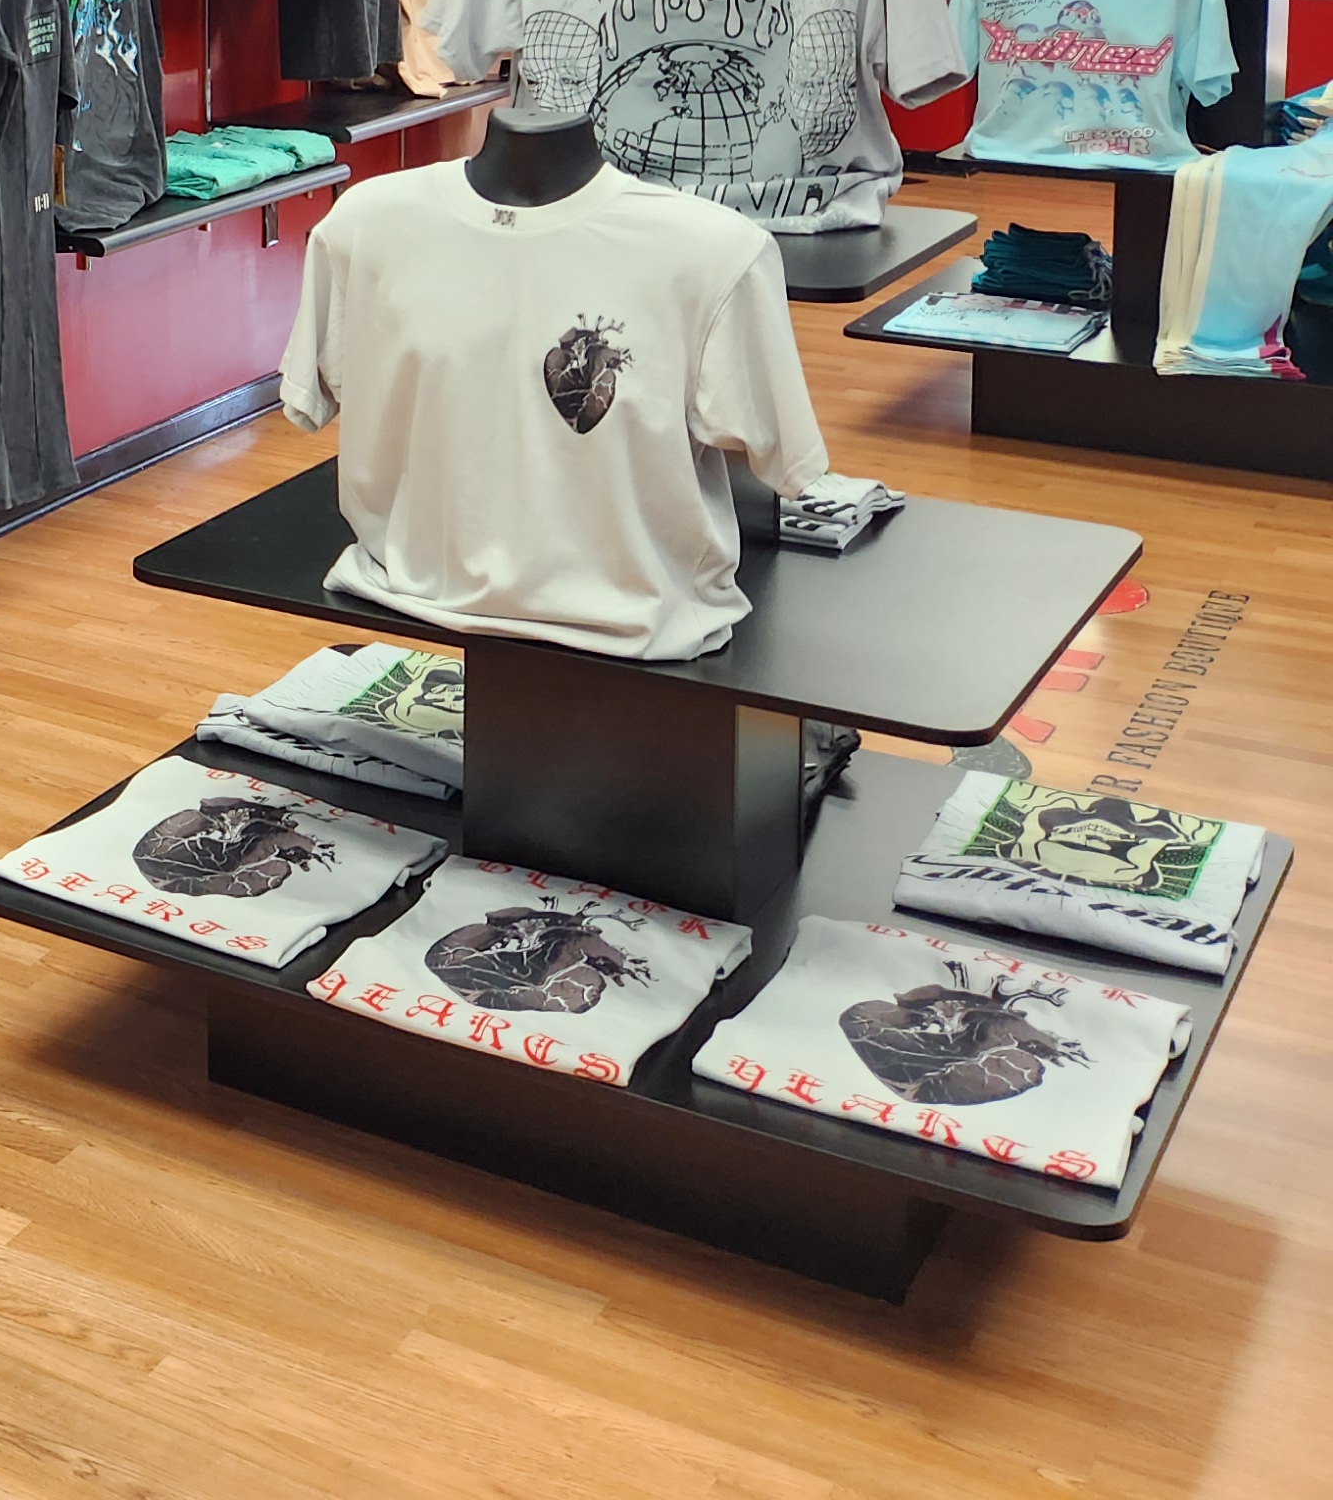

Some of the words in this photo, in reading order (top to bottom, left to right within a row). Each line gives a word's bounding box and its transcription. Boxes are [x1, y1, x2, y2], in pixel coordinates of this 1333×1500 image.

[1108, 126, 1156, 140] GOOD
[1067, 138, 1151, 157] TOUR
[1106, 678, 1198, 770] FASHION
